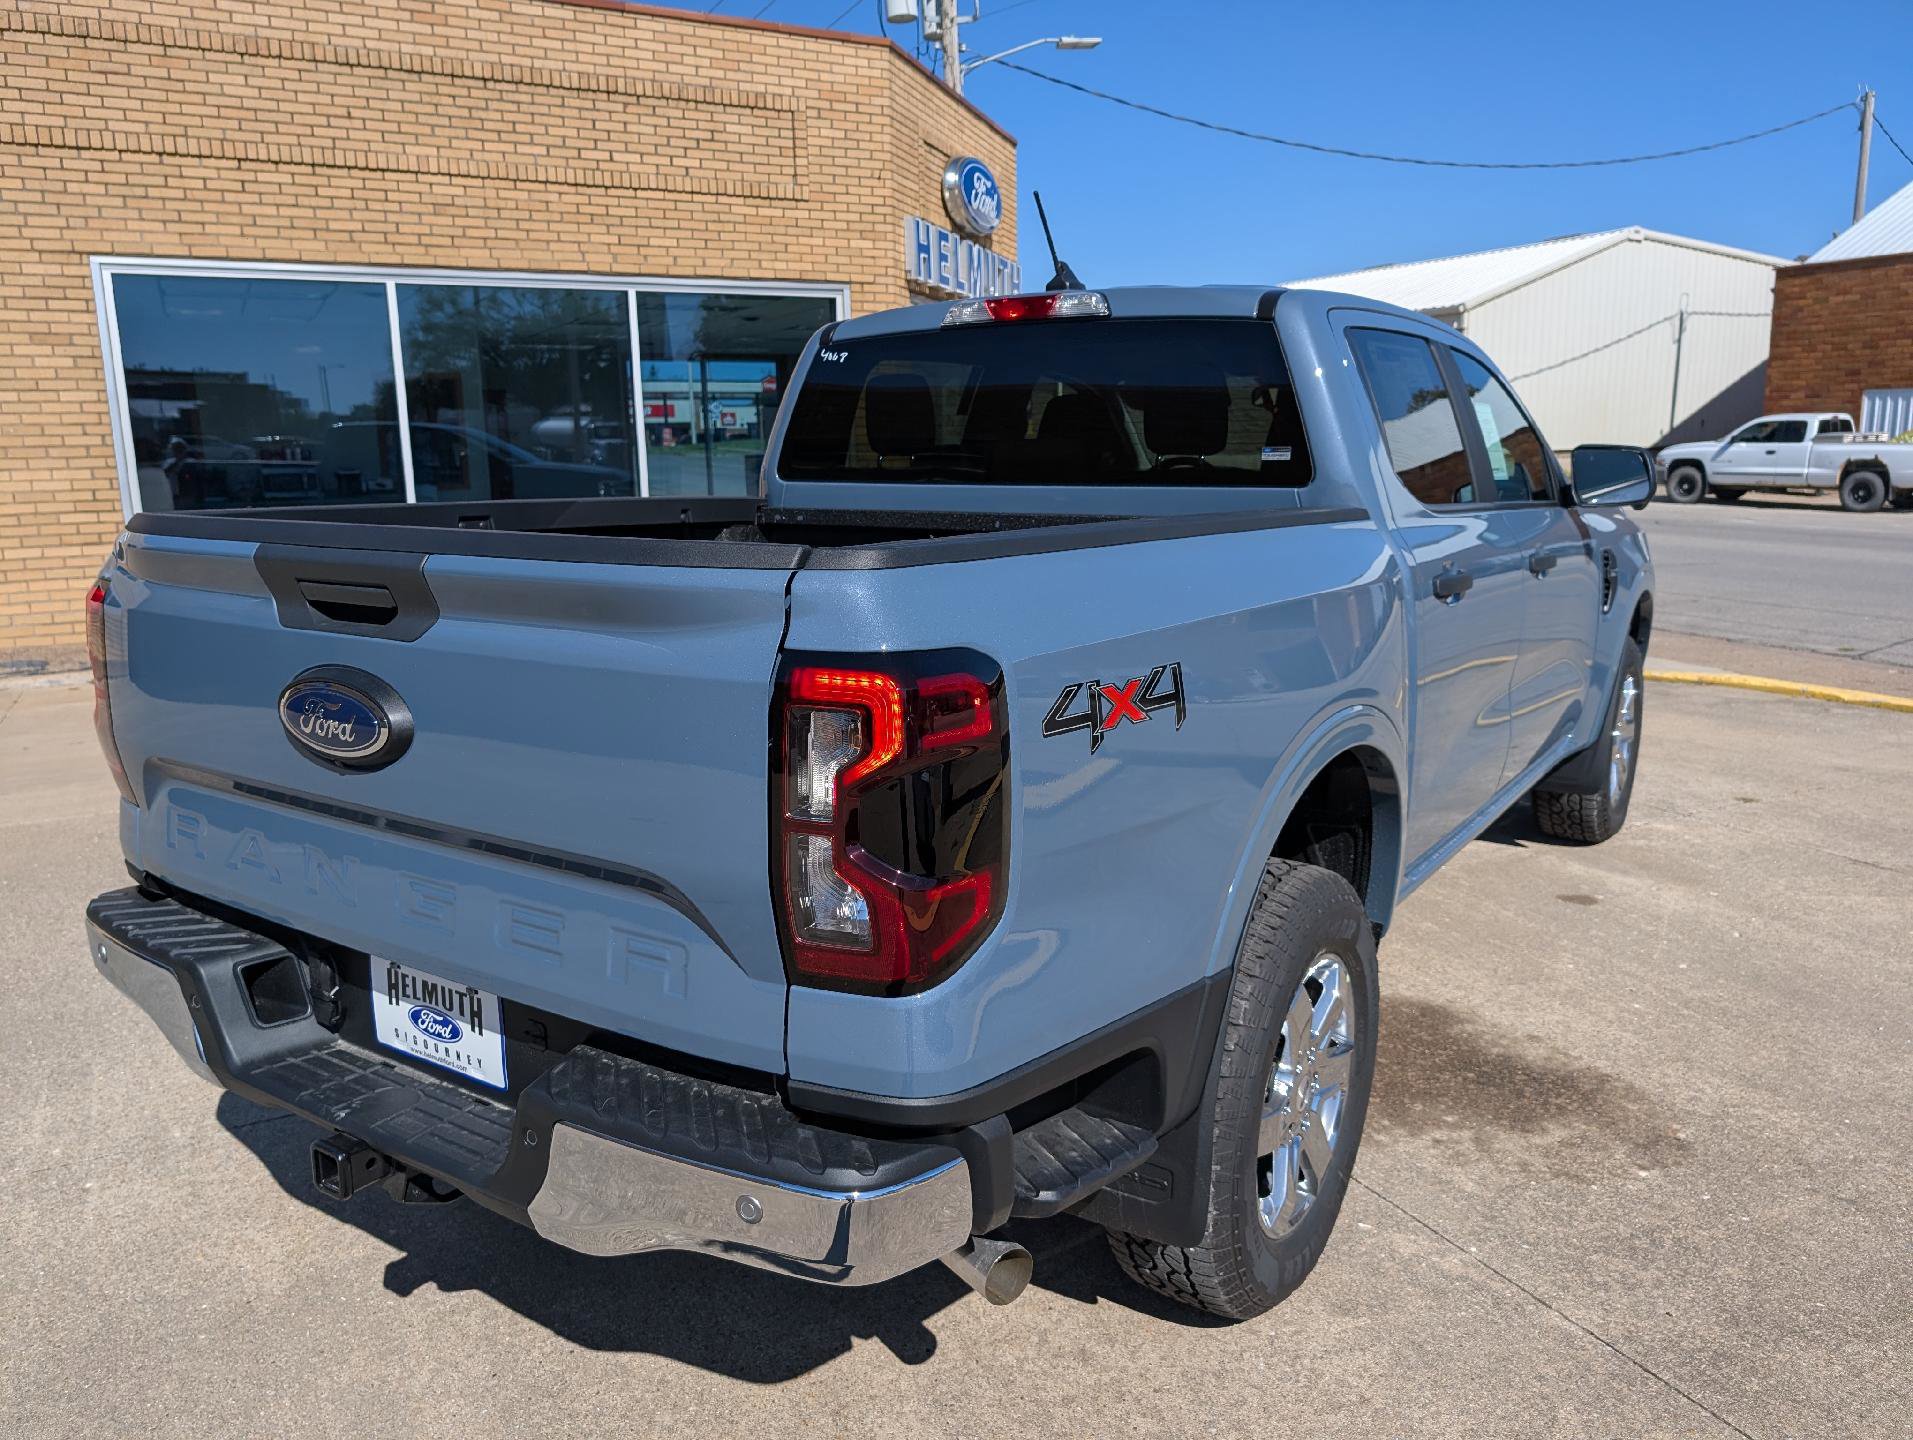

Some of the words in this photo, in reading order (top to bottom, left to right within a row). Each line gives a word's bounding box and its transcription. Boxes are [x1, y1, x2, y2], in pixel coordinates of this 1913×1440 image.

[971, 172, 998, 218] Ford
[910, 217, 1022, 298] HELMUTH
[300, 697, 357, 742] Ford
[166, 804, 690, 1000] RANGER
[386, 966, 484, 1037] HELMUTH
[417, 1009, 454, 1040] Ford
[394, 1027, 483, 1069] SIGOURNEY
